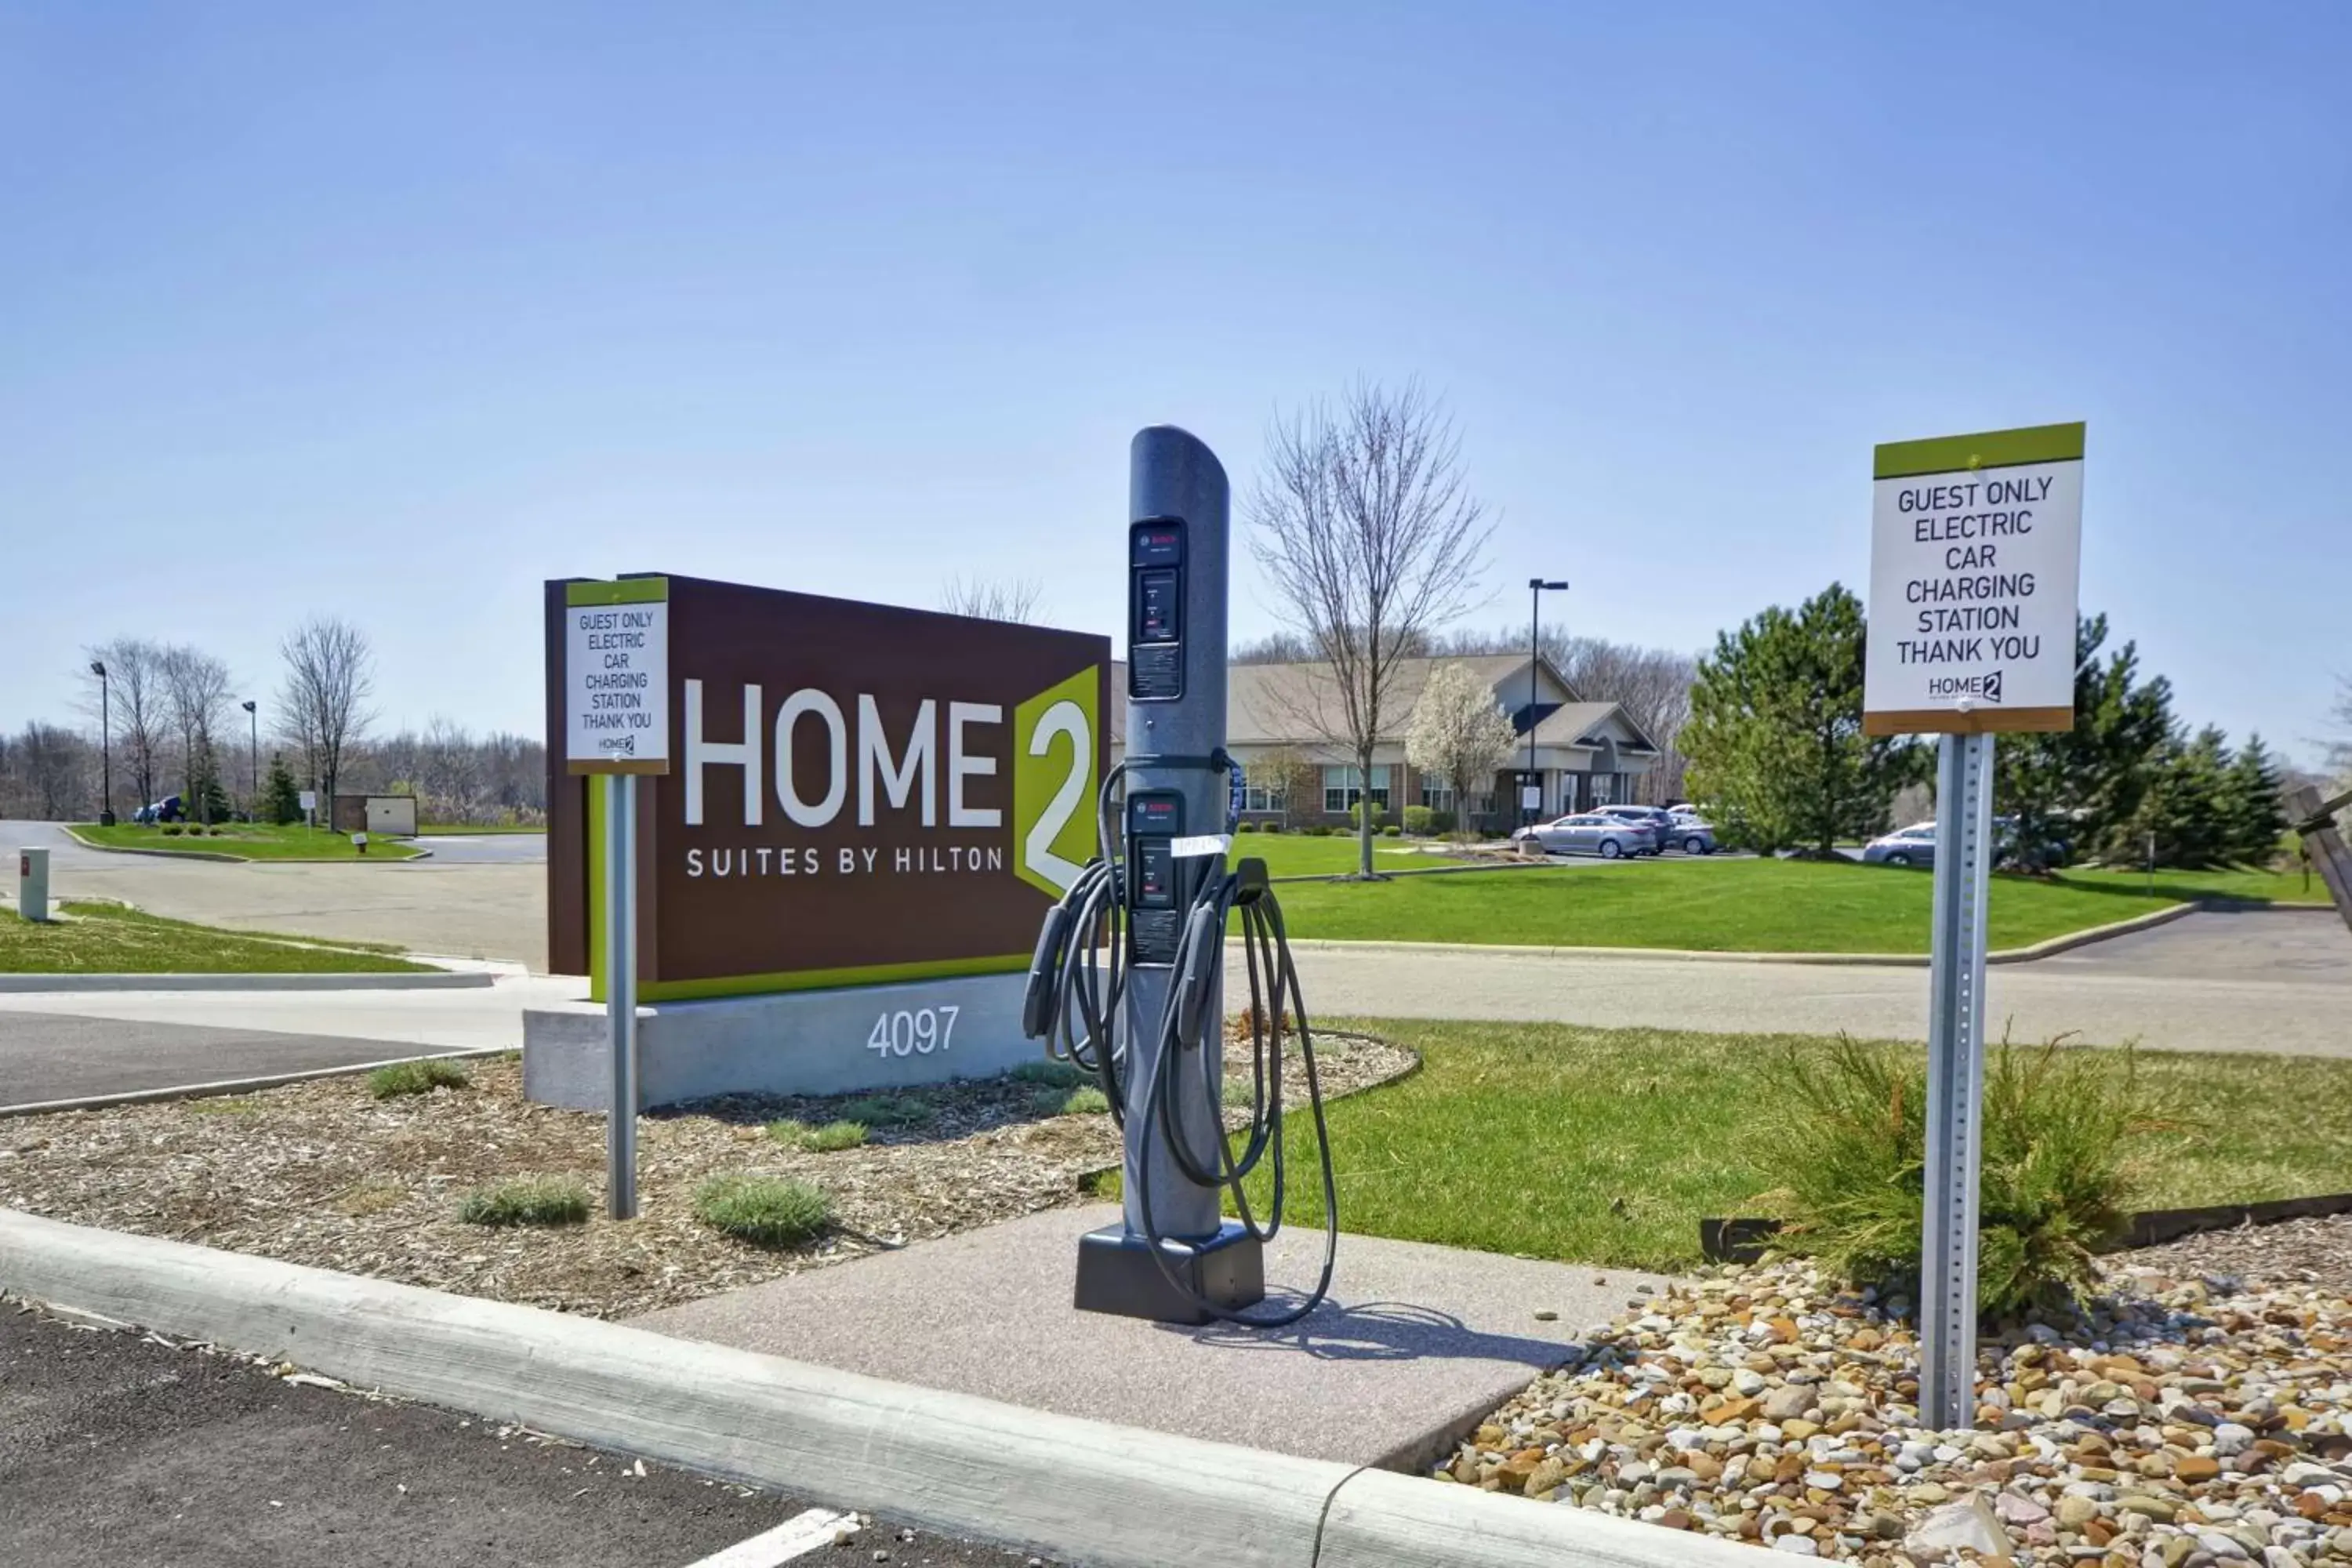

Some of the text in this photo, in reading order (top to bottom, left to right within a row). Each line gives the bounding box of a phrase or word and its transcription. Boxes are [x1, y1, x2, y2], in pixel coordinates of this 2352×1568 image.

[1898, 476, 2053, 513] GUEST ONLY
[1915, 510, 2033, 543] ELECTRIC
[1945, 544, 1997, 570] CAR
[1906, 572, 2035, 604] CHARGING
[579, 611, 653, 630] GUEST ONLY
[1918, 604, 2019, 633] STATION
[589, 633, 644, 650] ELECTRIC
[1896, 635, 2040, 665] THANK YOU
[604, 653, 629, 669] CAR
[586, 672, 648, 690] CHARGING
[592, 693, 641, 710] STATION
[582, 713, 652, 730] THANK YOU
[687, 847, 1003, 877] SUITES BY HILTON
[866, 1006, 960, 1058] 4097
